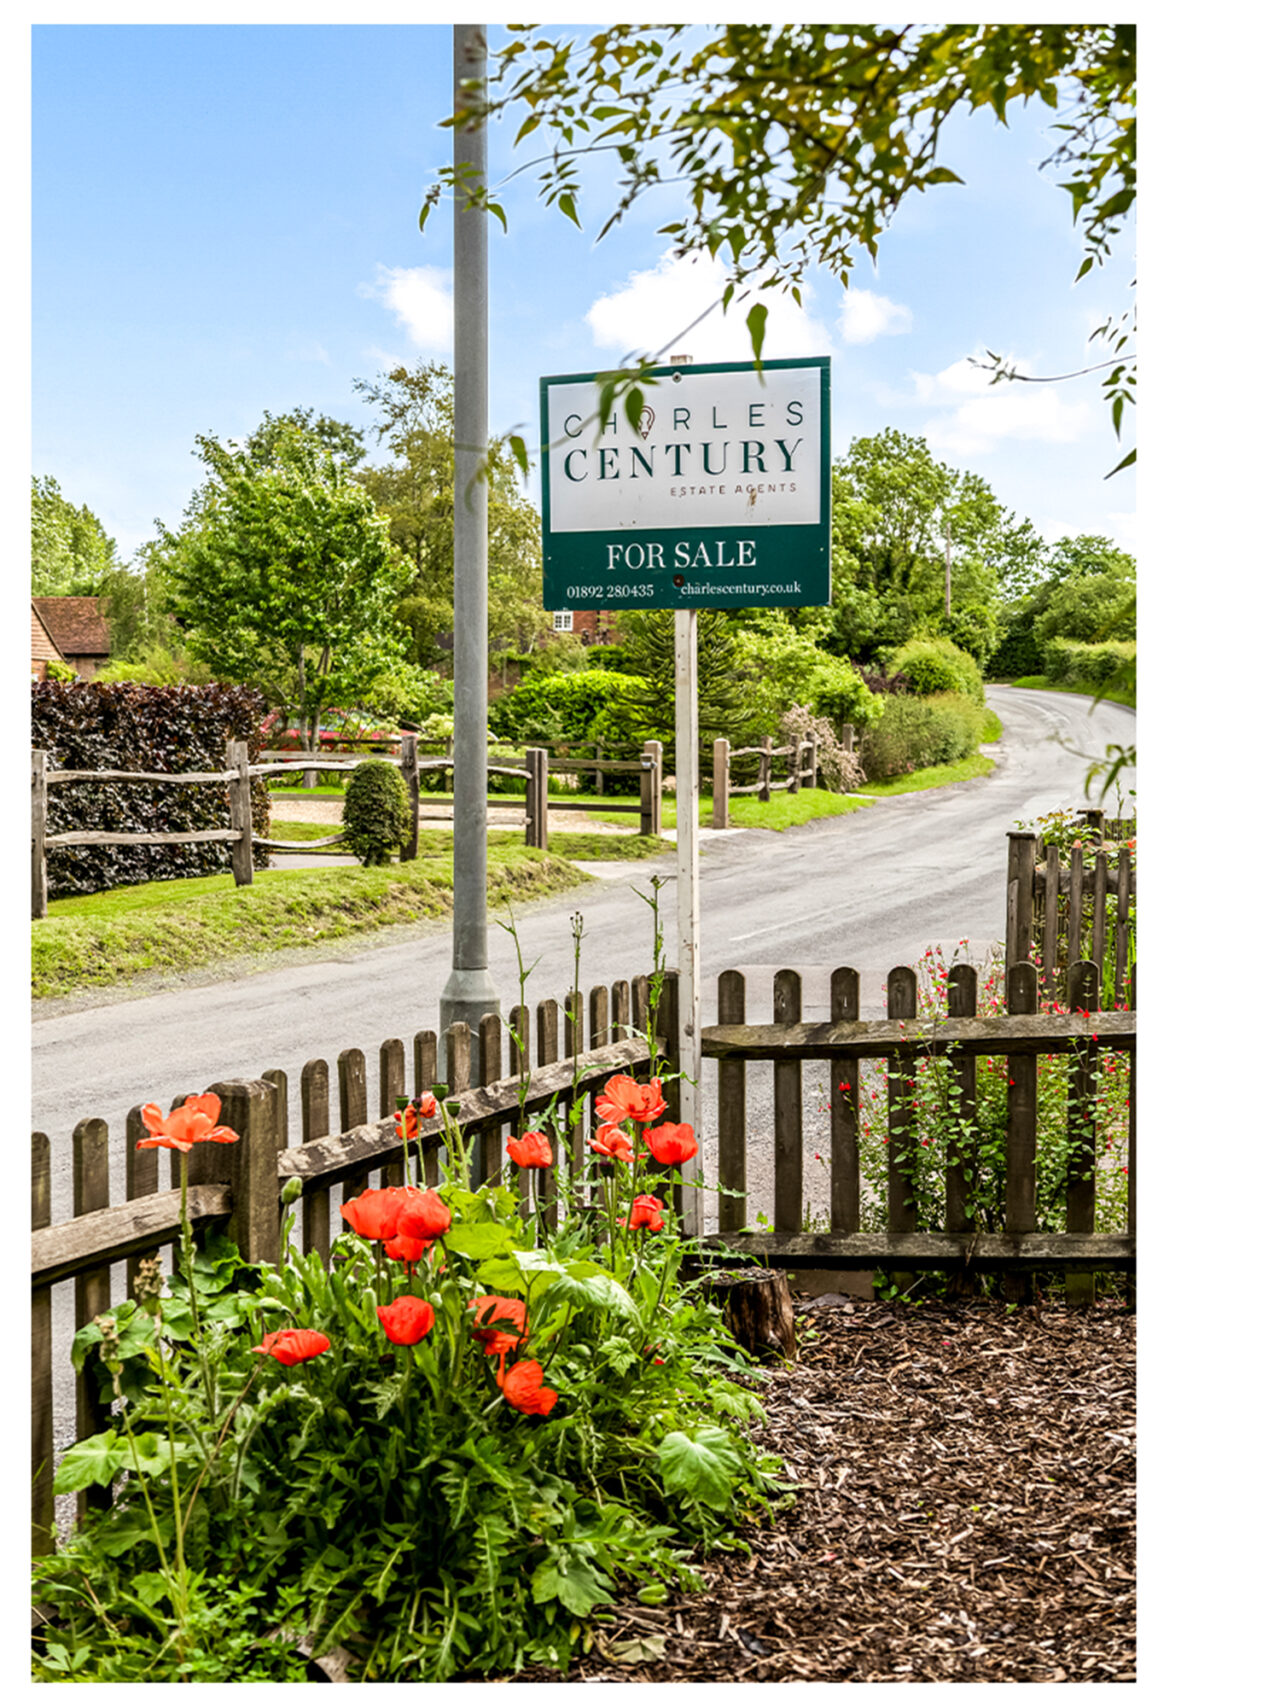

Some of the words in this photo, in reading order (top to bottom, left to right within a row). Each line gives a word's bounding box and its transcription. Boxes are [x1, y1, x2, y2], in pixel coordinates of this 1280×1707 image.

[564, 438, 804, 482] CENTURY
[670, 484, 726, 497] ESTATE
[734, 482, 797, 494] AGENTS
[606, 543, 665, 570] FOR
[673, 540, 757, 568] SALE
[566, 585, 603, 598] 01892
[606, 584, 654, 598] 280435
[680, 580, 802, 596] charlescentury.co.uk
